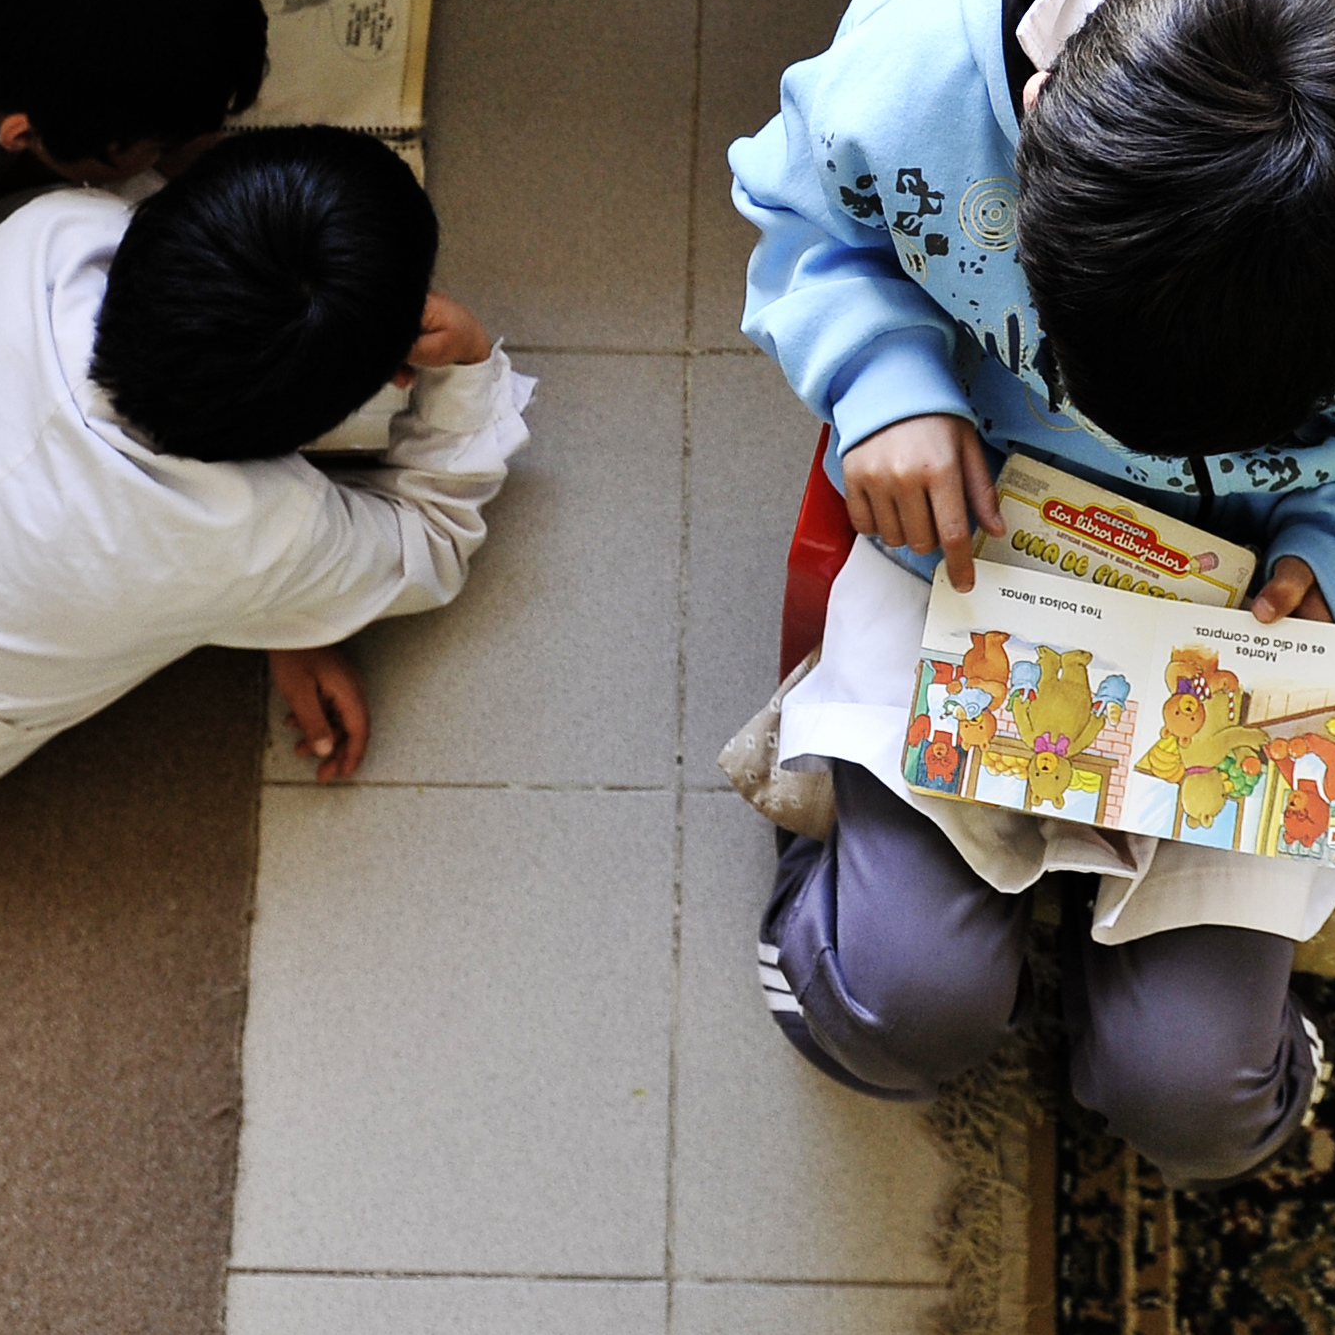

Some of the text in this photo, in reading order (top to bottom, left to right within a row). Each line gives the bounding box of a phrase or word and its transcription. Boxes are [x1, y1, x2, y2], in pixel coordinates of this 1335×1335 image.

[1093, 509, 1149, 540] COLECCION
[1072, 515, 1115, 543] libros
[1112, 530, 1192, 572] dibujados
[998, 586, 1103, 619] Tres bolsas llenas.
[1193, 626, 1326, 655] es el día de compras.
[1235, 645, 1277, 662] Martes
